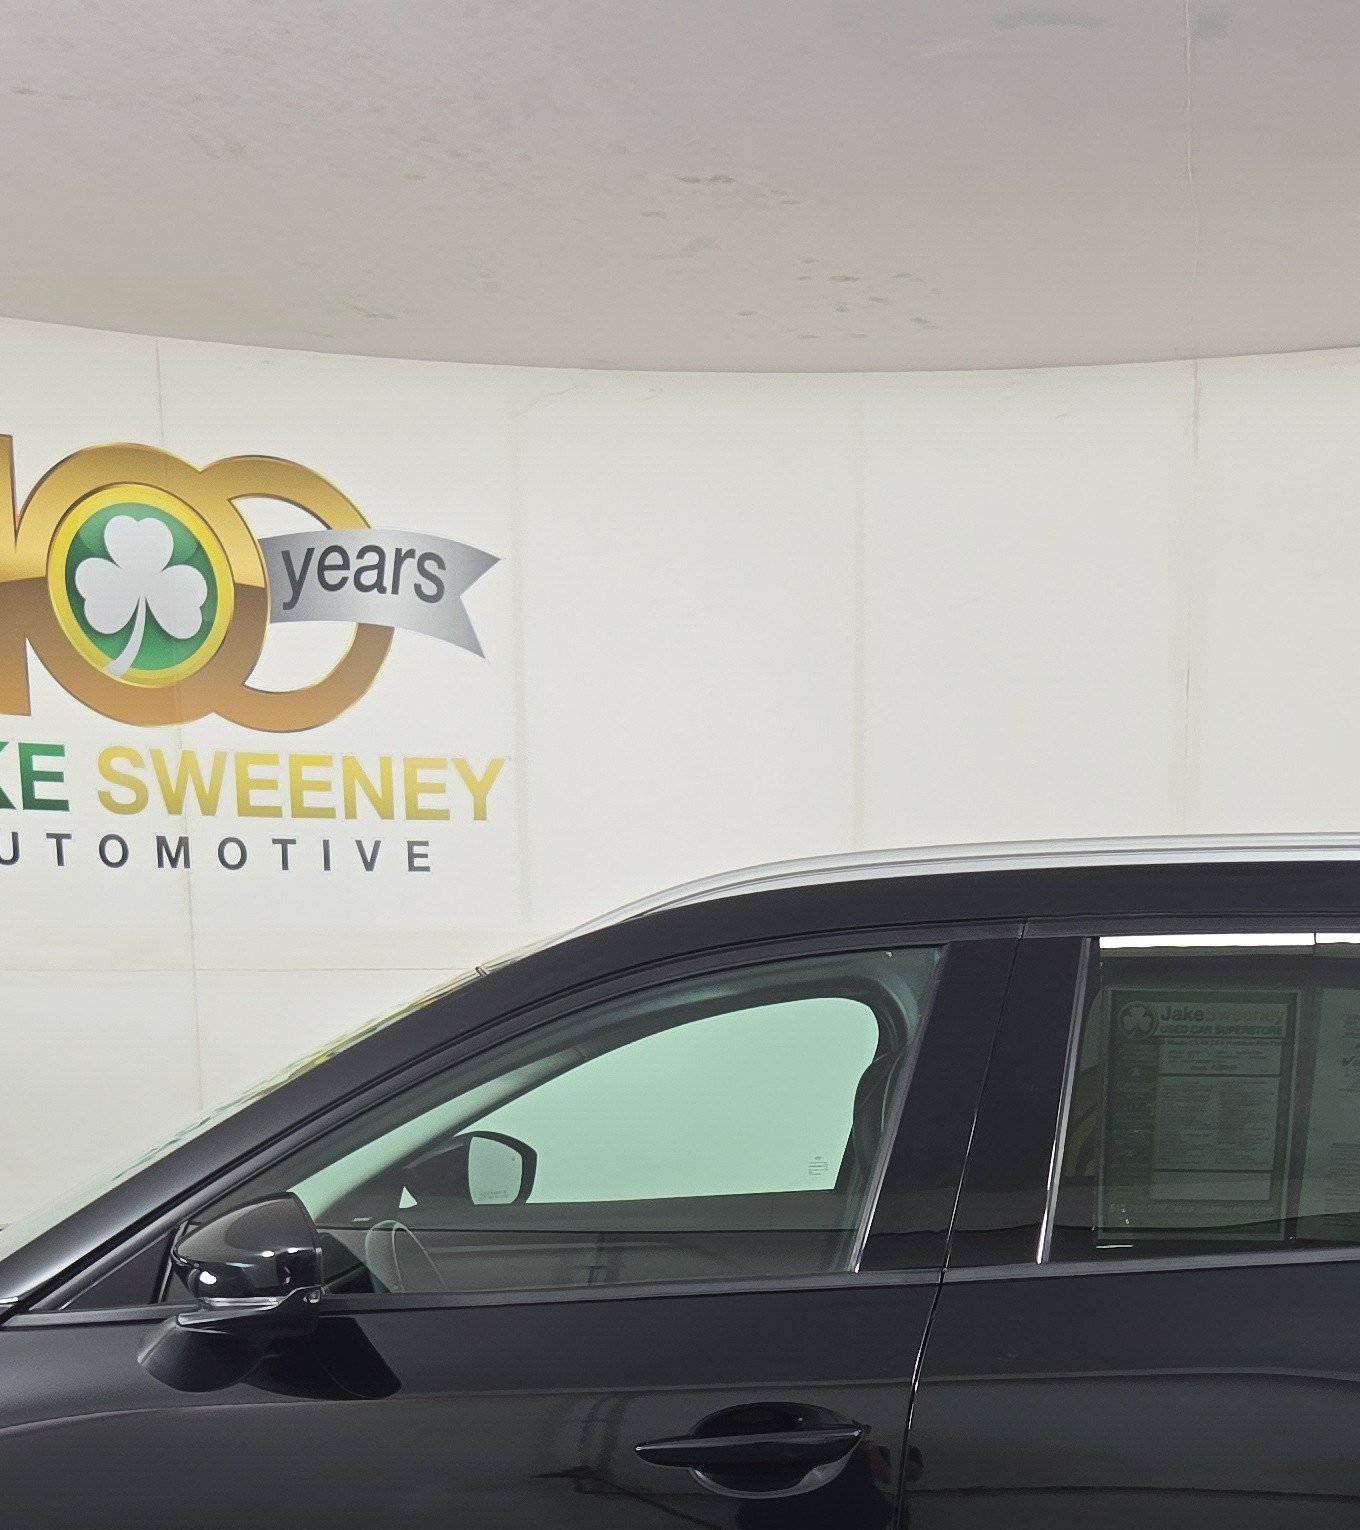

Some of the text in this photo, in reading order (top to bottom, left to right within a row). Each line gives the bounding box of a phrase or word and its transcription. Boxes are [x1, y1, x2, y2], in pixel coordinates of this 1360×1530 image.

[280, 543, 447, 611] years
[96, 745, 506, 821] SWEENEY
[1161, 1006, 1204, 1021] Jake
